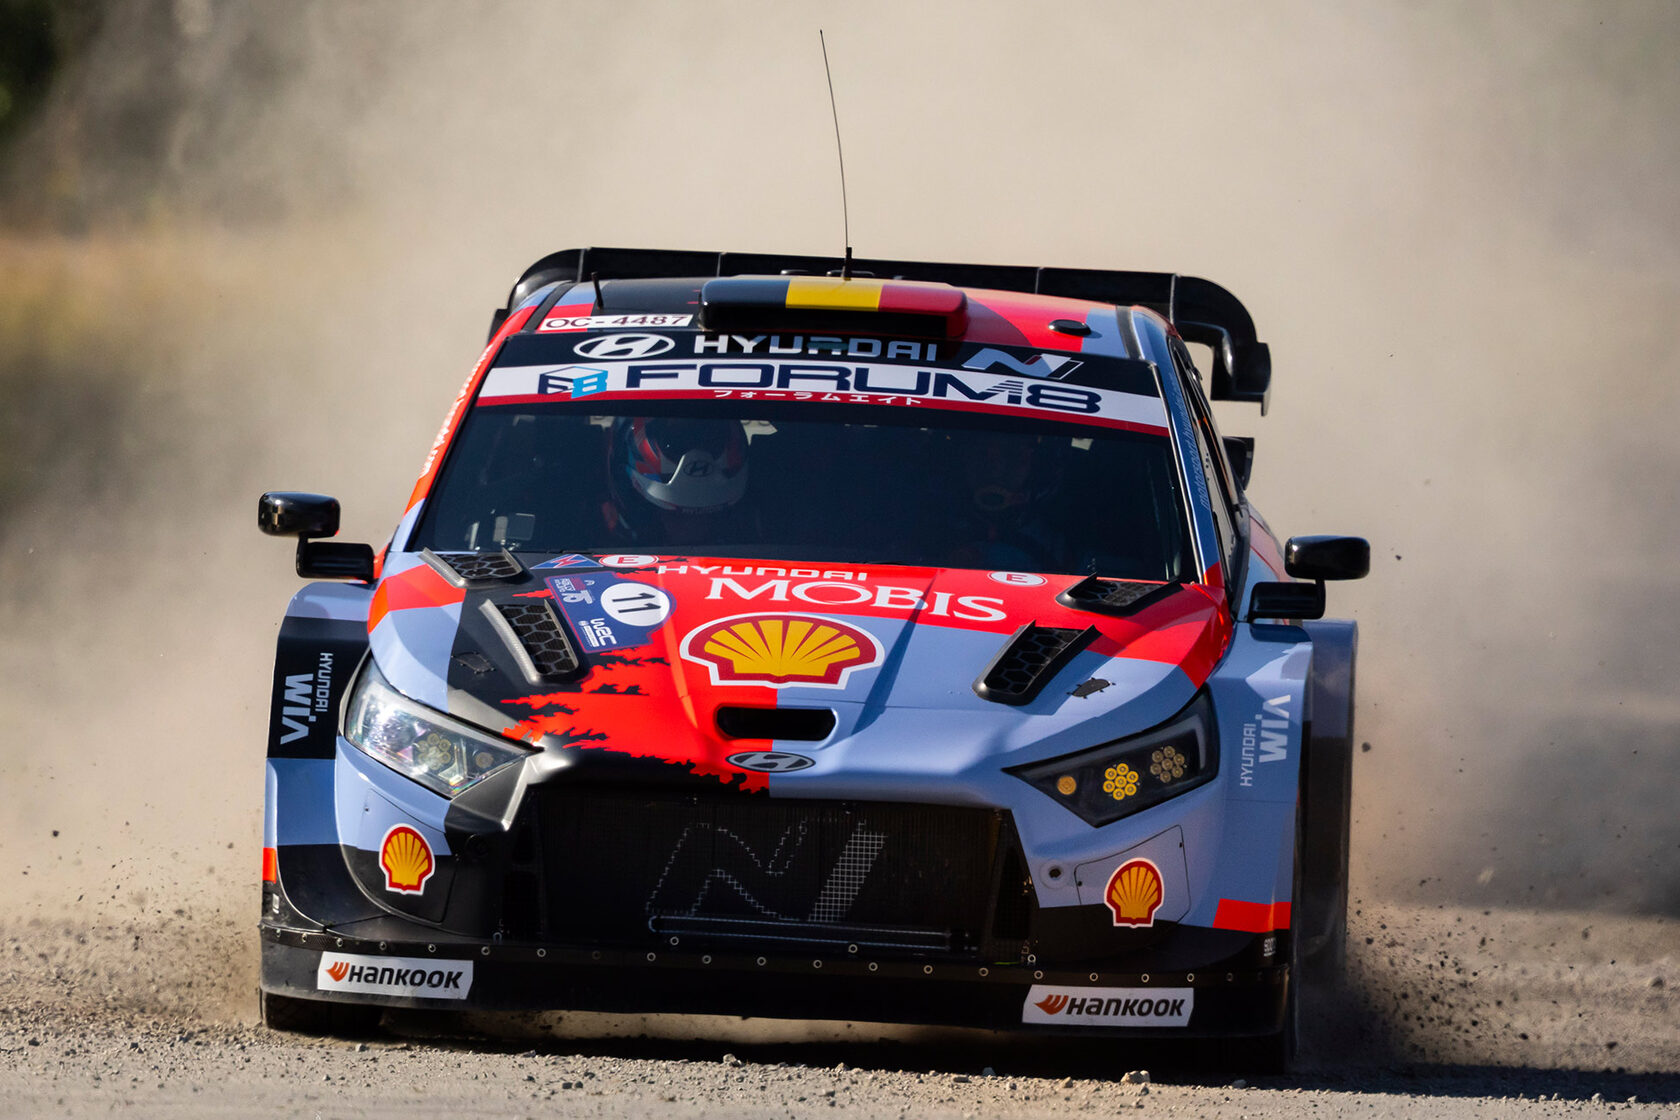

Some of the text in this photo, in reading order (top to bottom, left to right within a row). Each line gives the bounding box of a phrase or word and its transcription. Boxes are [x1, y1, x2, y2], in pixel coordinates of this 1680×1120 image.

[694, 334, 938, 362] HYUNDAI
[714, 389, 922, 406] フォーラムエイト
[617, 555, 640, 565] E
[657, 565, 868, 582] HYUNDAI
[1006, 573, 1028, 586] E
[612, 592, 662, 614] 11
[704, 577, 1008, 622] MOBIS
[314, 652, 334, 712] HYUNDAI
[280, 673, 317, 745] WIA
[1255, 694, 1291, 763] WIA
[1240, 723, 1256, 787] HYUNDAI
